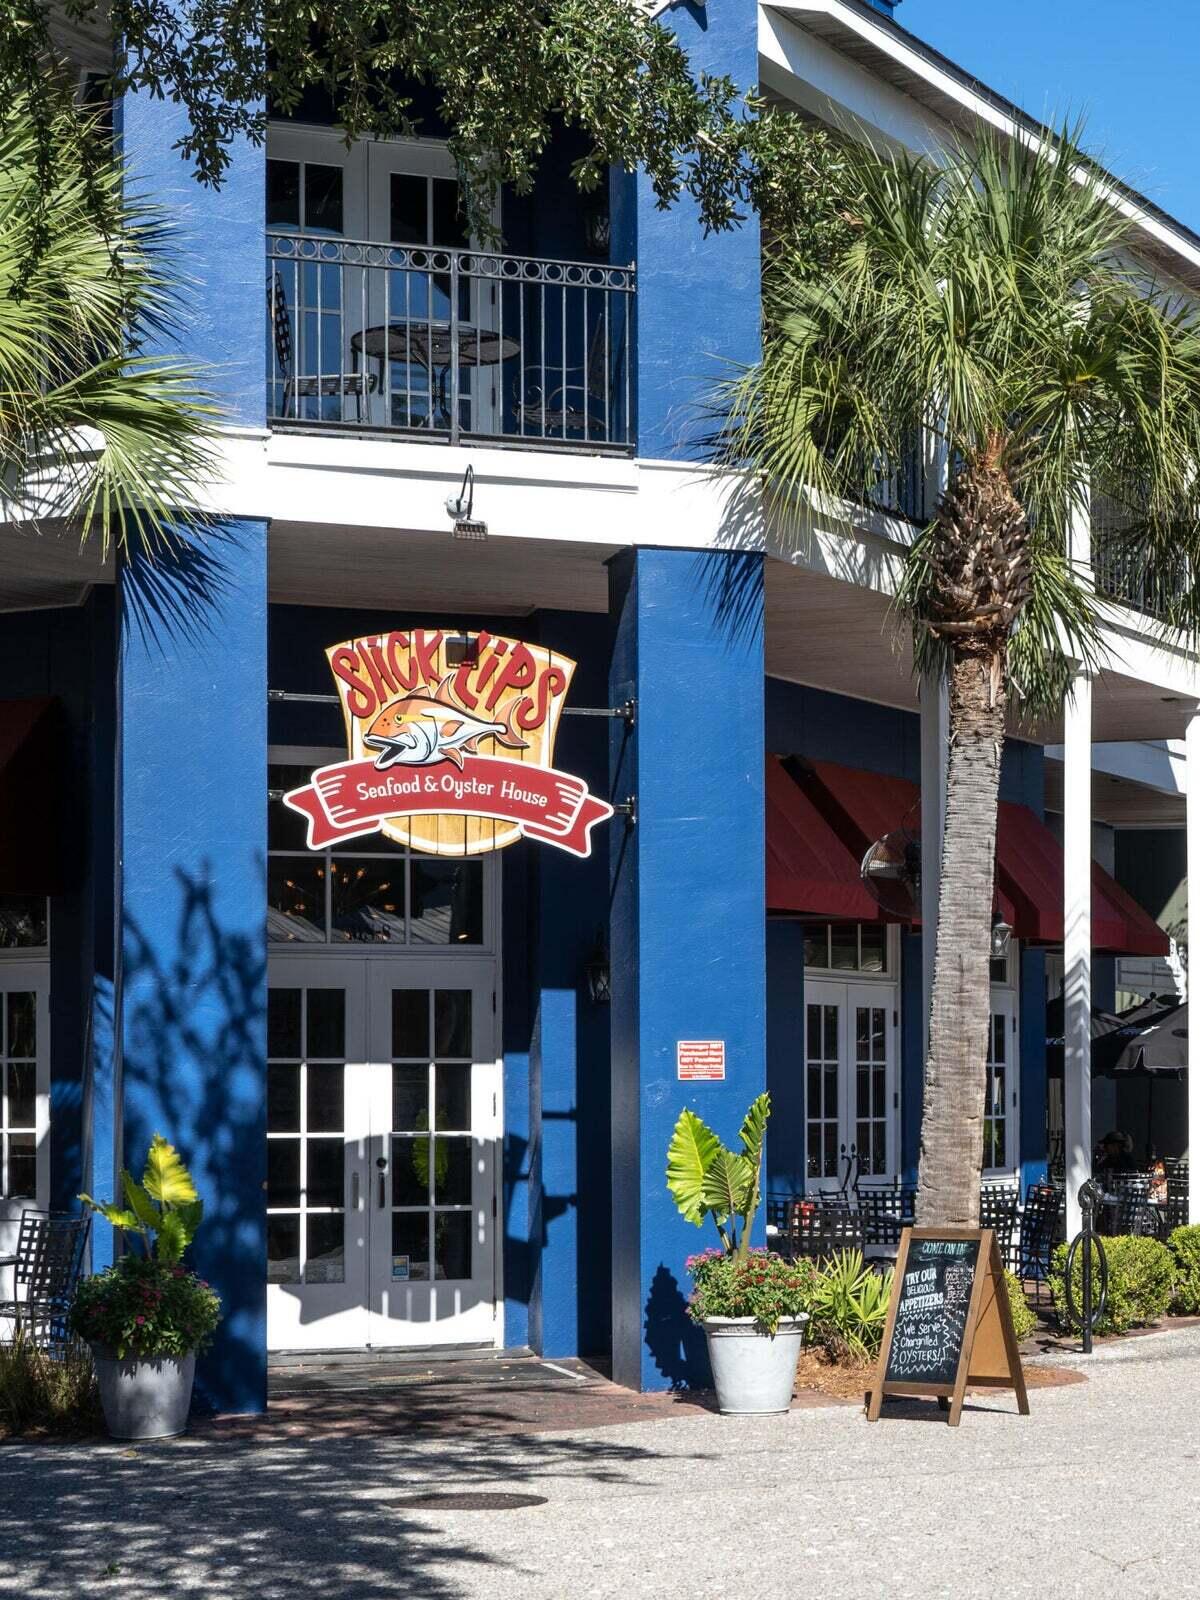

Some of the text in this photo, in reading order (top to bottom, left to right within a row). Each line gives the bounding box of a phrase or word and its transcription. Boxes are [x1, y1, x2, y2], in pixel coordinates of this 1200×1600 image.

[356, 774, 549, 808] Seafood & Oyster House
[922, 1242, 944, 1254] COME
[944, 1243, 955, 1255] ON
[906, 1271, 920, 1285] TRY
[921, 1267, 937, 1283] OUR
[906, 1283, 935, 1297] DELICIOUS
[899, 1292, 943, 1311] APPETIZERS
[903, 1322, 942, 1335] We Serve
[900, 1335, 939, 1349] Chargrilled
[899, 1347, 942, 1364] OYSTERS!
